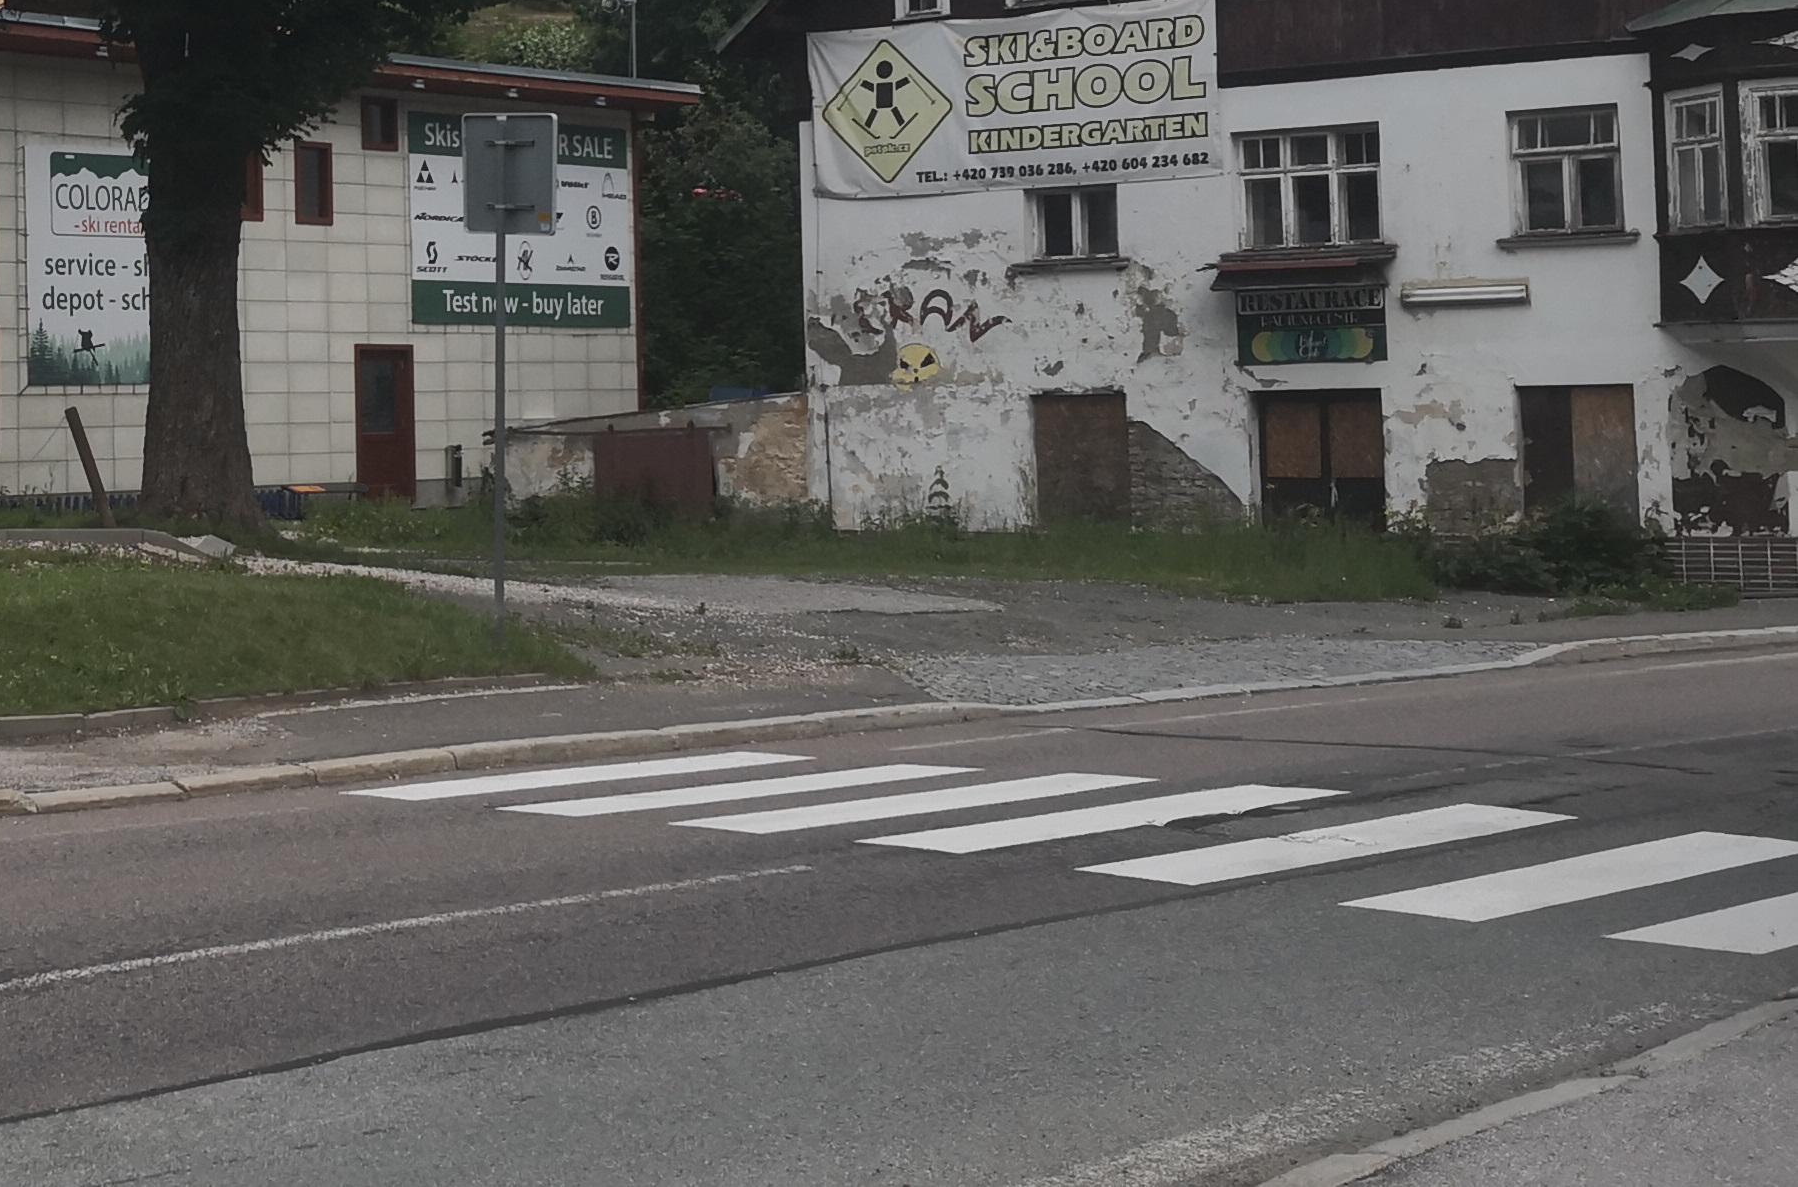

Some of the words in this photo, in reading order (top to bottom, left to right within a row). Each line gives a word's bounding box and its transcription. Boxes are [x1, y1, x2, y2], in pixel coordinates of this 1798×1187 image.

[963, 14, 1205, 67] SKI&BOARD
[964, 55, 1206, 117] SCHOOL
[424, 122, 460, 148] Skis
[573, 134, 614, 159] SALE
[967, 112, 1208, 155] KINDERGARTEN
[916, 170, 948, 184] TEL.:
[952, 167, 986, 182] +420
[990, 166, 1015, 180] 739
[1018, 164, 1044, 178] 036
[1047, 161, 1077, 177] 286,
[1081, 159, 1117, 174] +420
[1121, 156, 1148, 171] 604
[1152, 154, 1179, 169] 234
[1182, 152, 1210, 167] 682
[55, 183, 150, 213] COLORAD
[104, 220, 144, 235] renta
[44, 253, 116, 276] service
[42, 286, 104, 316] depot
[121, 286, 150, 311] sch
[442, 289, 478, 313] Test
[482, 296, 519, 314] nw
[533, 291, 564, 320] buy
[568, 292, 604, 315] later
